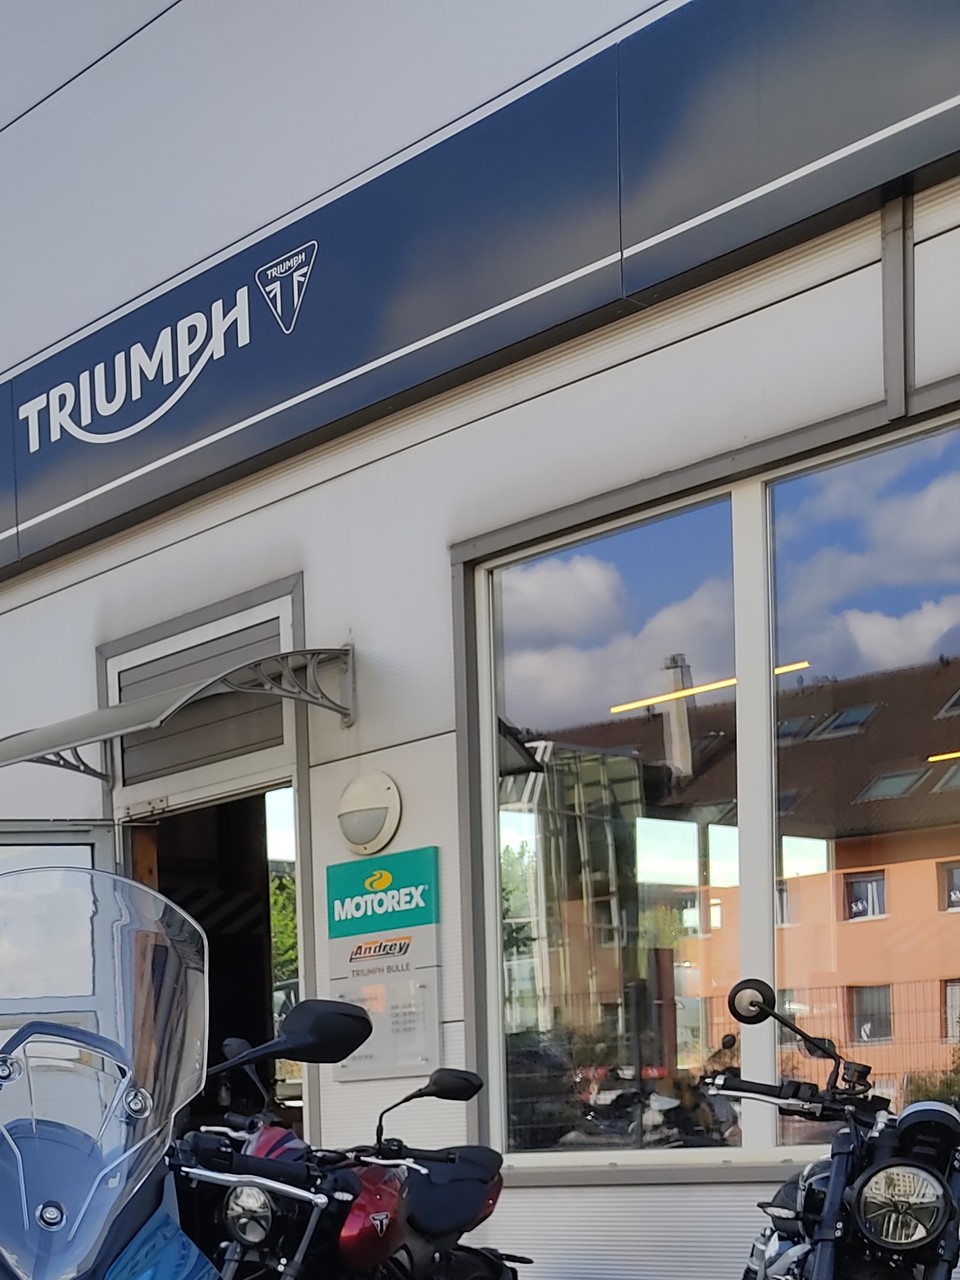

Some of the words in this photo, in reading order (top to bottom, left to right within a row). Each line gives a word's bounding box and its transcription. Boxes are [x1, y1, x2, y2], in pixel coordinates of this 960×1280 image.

[266, 252, 306, 279] TRIUMPH
[18, 286, 250, 453] TRIUMPH
[333, 885, 426, 922] MOTOREX
[353, 941, 409, 957] Andrey
[351, 966, 385, 978] TRIUMPH
[386, 962, 411, 974] BULLE
